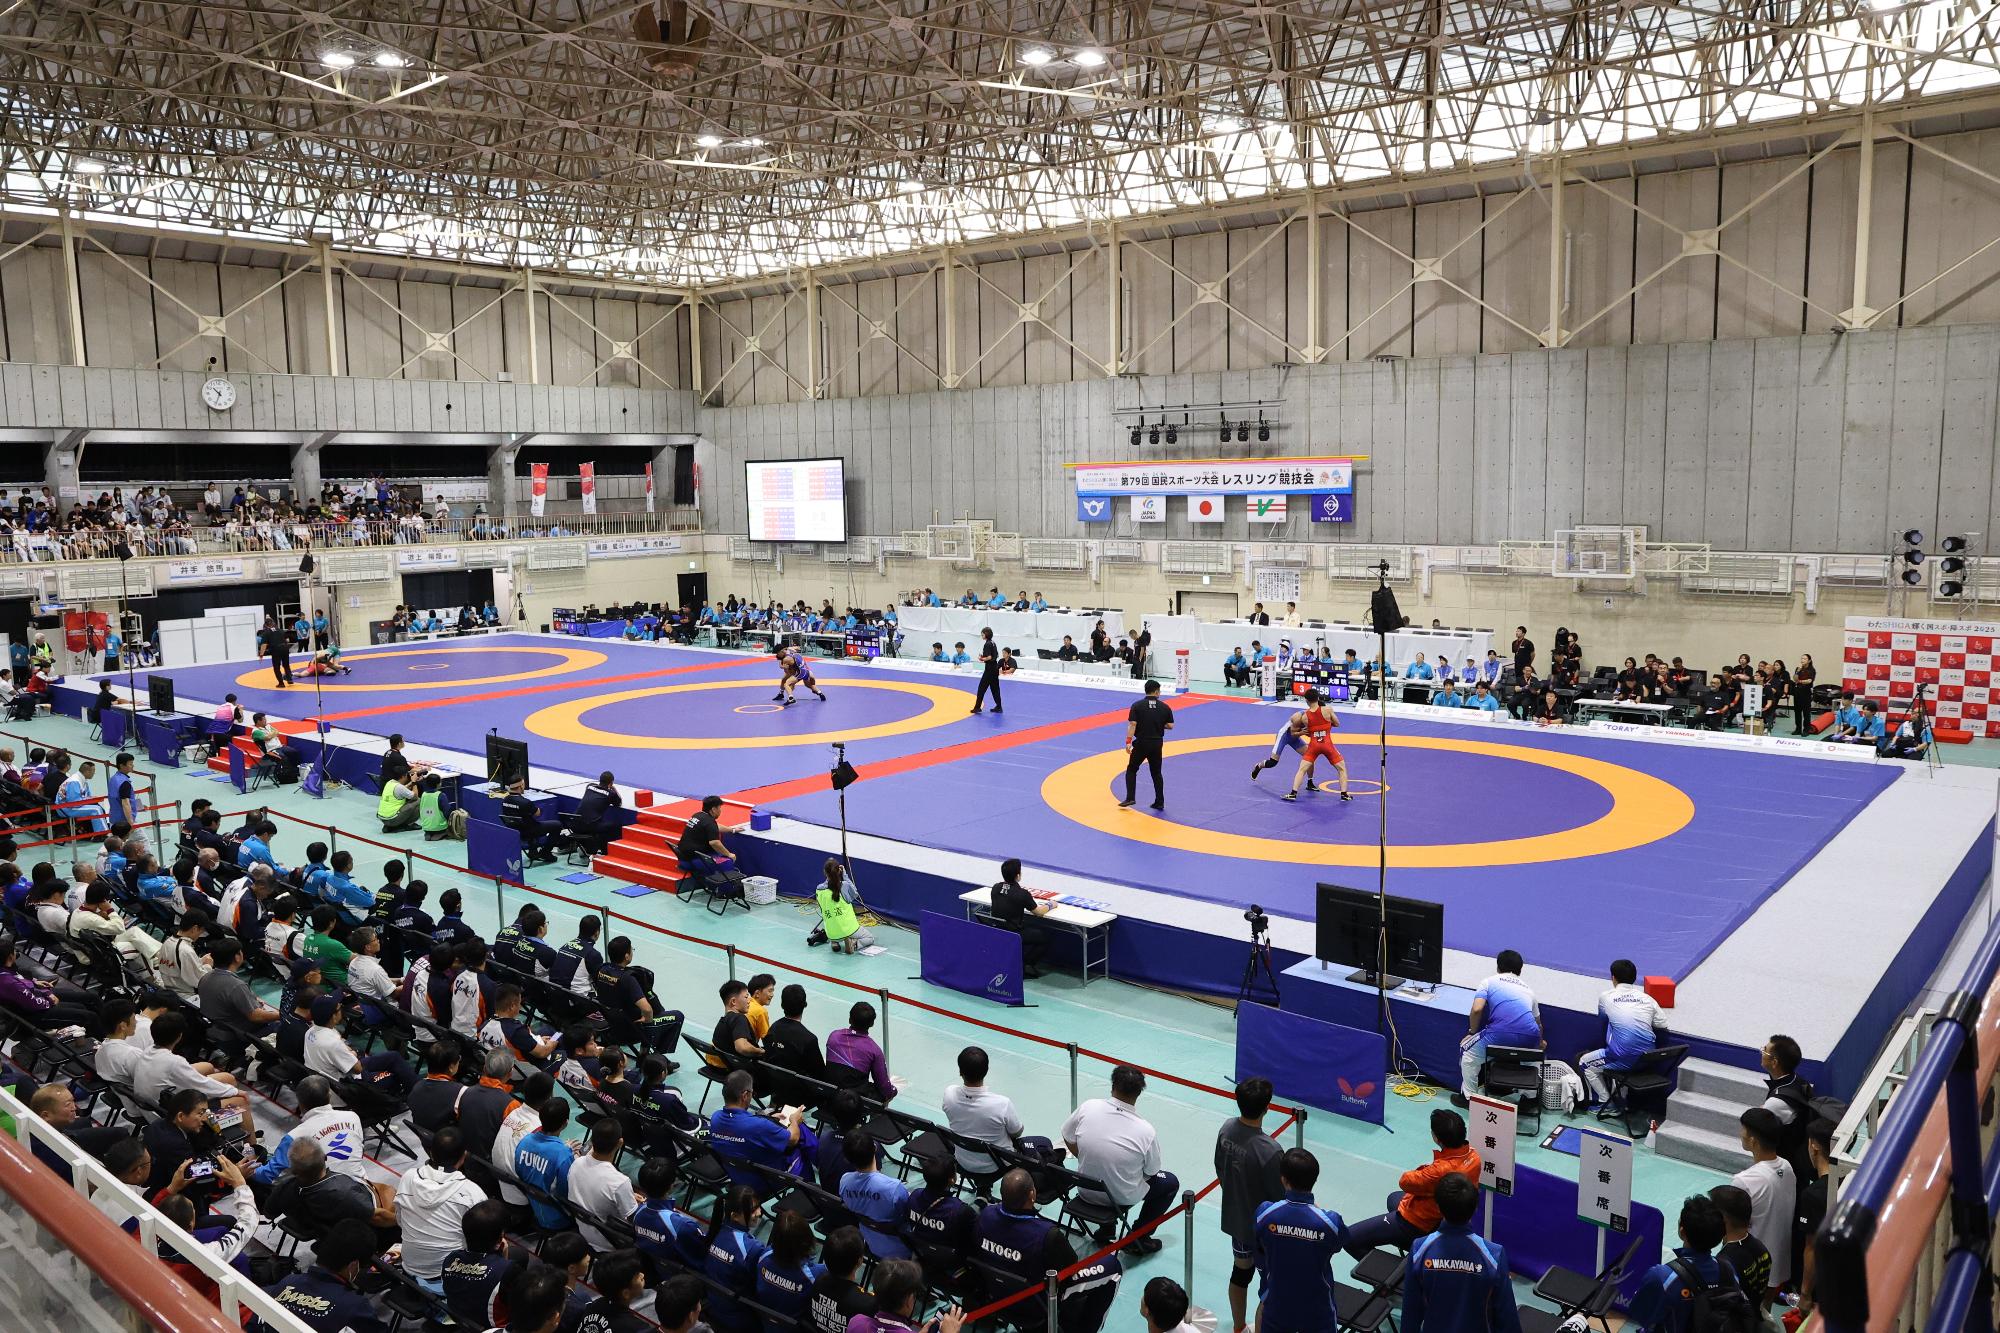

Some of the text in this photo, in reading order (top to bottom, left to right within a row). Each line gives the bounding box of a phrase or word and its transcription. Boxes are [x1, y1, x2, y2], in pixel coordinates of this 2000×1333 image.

[1121, 476, 1150, 486] 第79回
[1151, 475, 1219, 486] 国民スポーツ大会
[1222, 472, 1314, 486] レスリング競技会
[1341, 1094, 1368, 1108] Butterfly
[1484, 1111, 1497, 1175] 次番席
[519, 1150, 548, 1174] FUKUI
[1596, 1144, 1612, 1210] 次番席
[910, 1209, 944, 1231] HYOGO
[1276, 1224, 1318, 1240] WAKAYAMA
[981, 1237, 1022, 1262] HYOGO
[445, 1258, 487, 1275] Iwate
[1432, 1259, 1474, 1272] WAKAYAMA
[765, 1271, 796, 1291] WAKAYAMA
[275, 1286, 331, 1310] Iwate
[819, 1293, 837, 1312] TEAM
